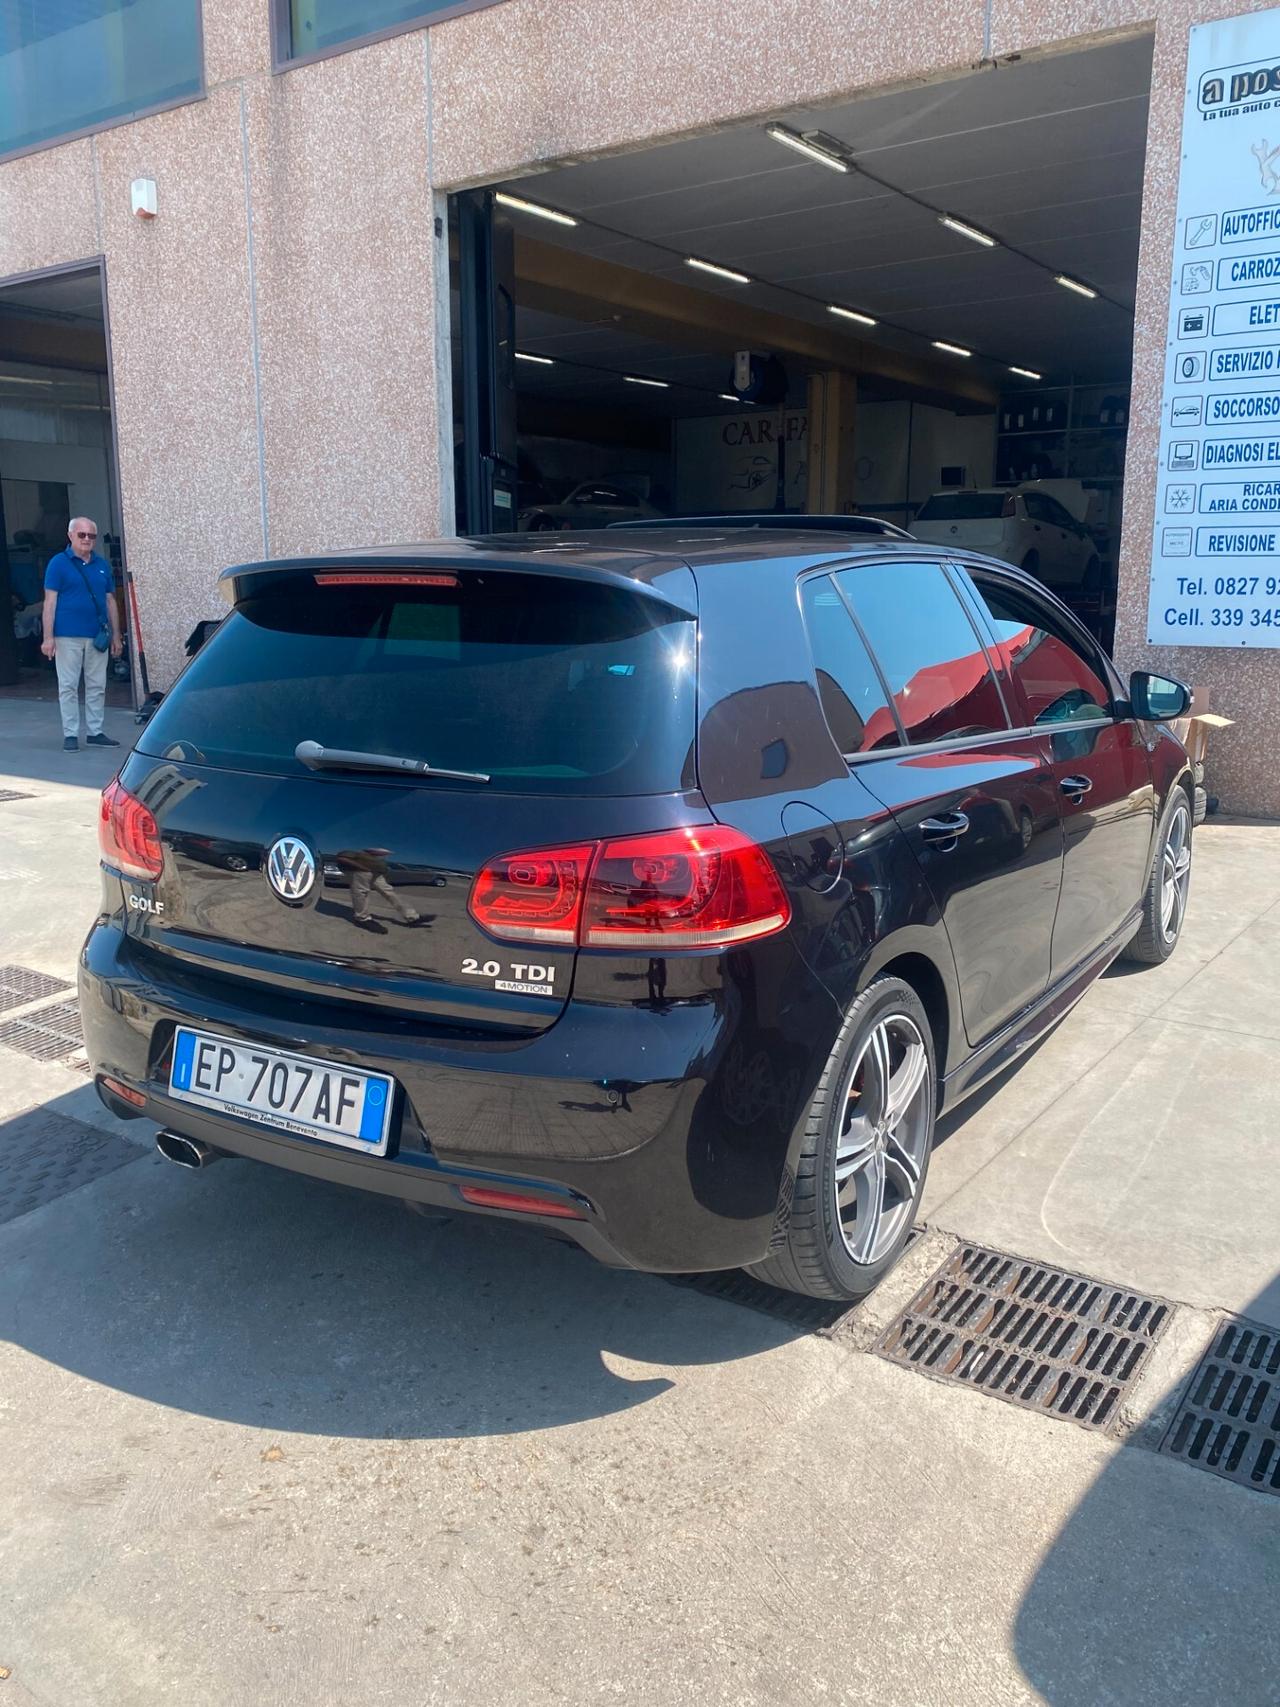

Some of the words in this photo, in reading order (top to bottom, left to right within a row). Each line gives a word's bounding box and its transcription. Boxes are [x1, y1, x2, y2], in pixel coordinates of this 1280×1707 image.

[1203, 111, 1216, 121] La
[1219, 108, 1239, 118] tua
[1242, 101, 1271, 114] auto
[1224, 208, 1280, 236] AUTOFFIC
[1231, 256, 1280, 282] CARROZ
[1249, 303, 1280, 325] ELET
[1216, 350, 1273, 373] SERVIZIO
[1213, 396, 1280, 419] SOCCORSO
[722, 419, 775, 446] CAR
[1206, 442, 1264, 464] DIAGNOSI
[1243, 483, 1280, 496] RICAR
[1208, 499, 1238, 511] ARIA
[1208, 534, 1276, 552] REVISIONE
[1177, 577, 1208, 596] Tel.
[1214, 577, 1259, 595] 0827
[1165, 608, 1204, 627] Cell.
[1211, 608, 1244, 627] 339
[129, 894, 164, 915] GOLF
[461, 958, 500, 977] 2.0
[510, 963, 555, 982] TDI
[500, 982, 548, 993] 4MOTION
[195, 1042, 236, 1093] EP
[247, 1056, 360, 1126] 707AF
[223, 1103, 259, 1119] Volkswagen
[260, 1114, 285, 1127] Zentrum
